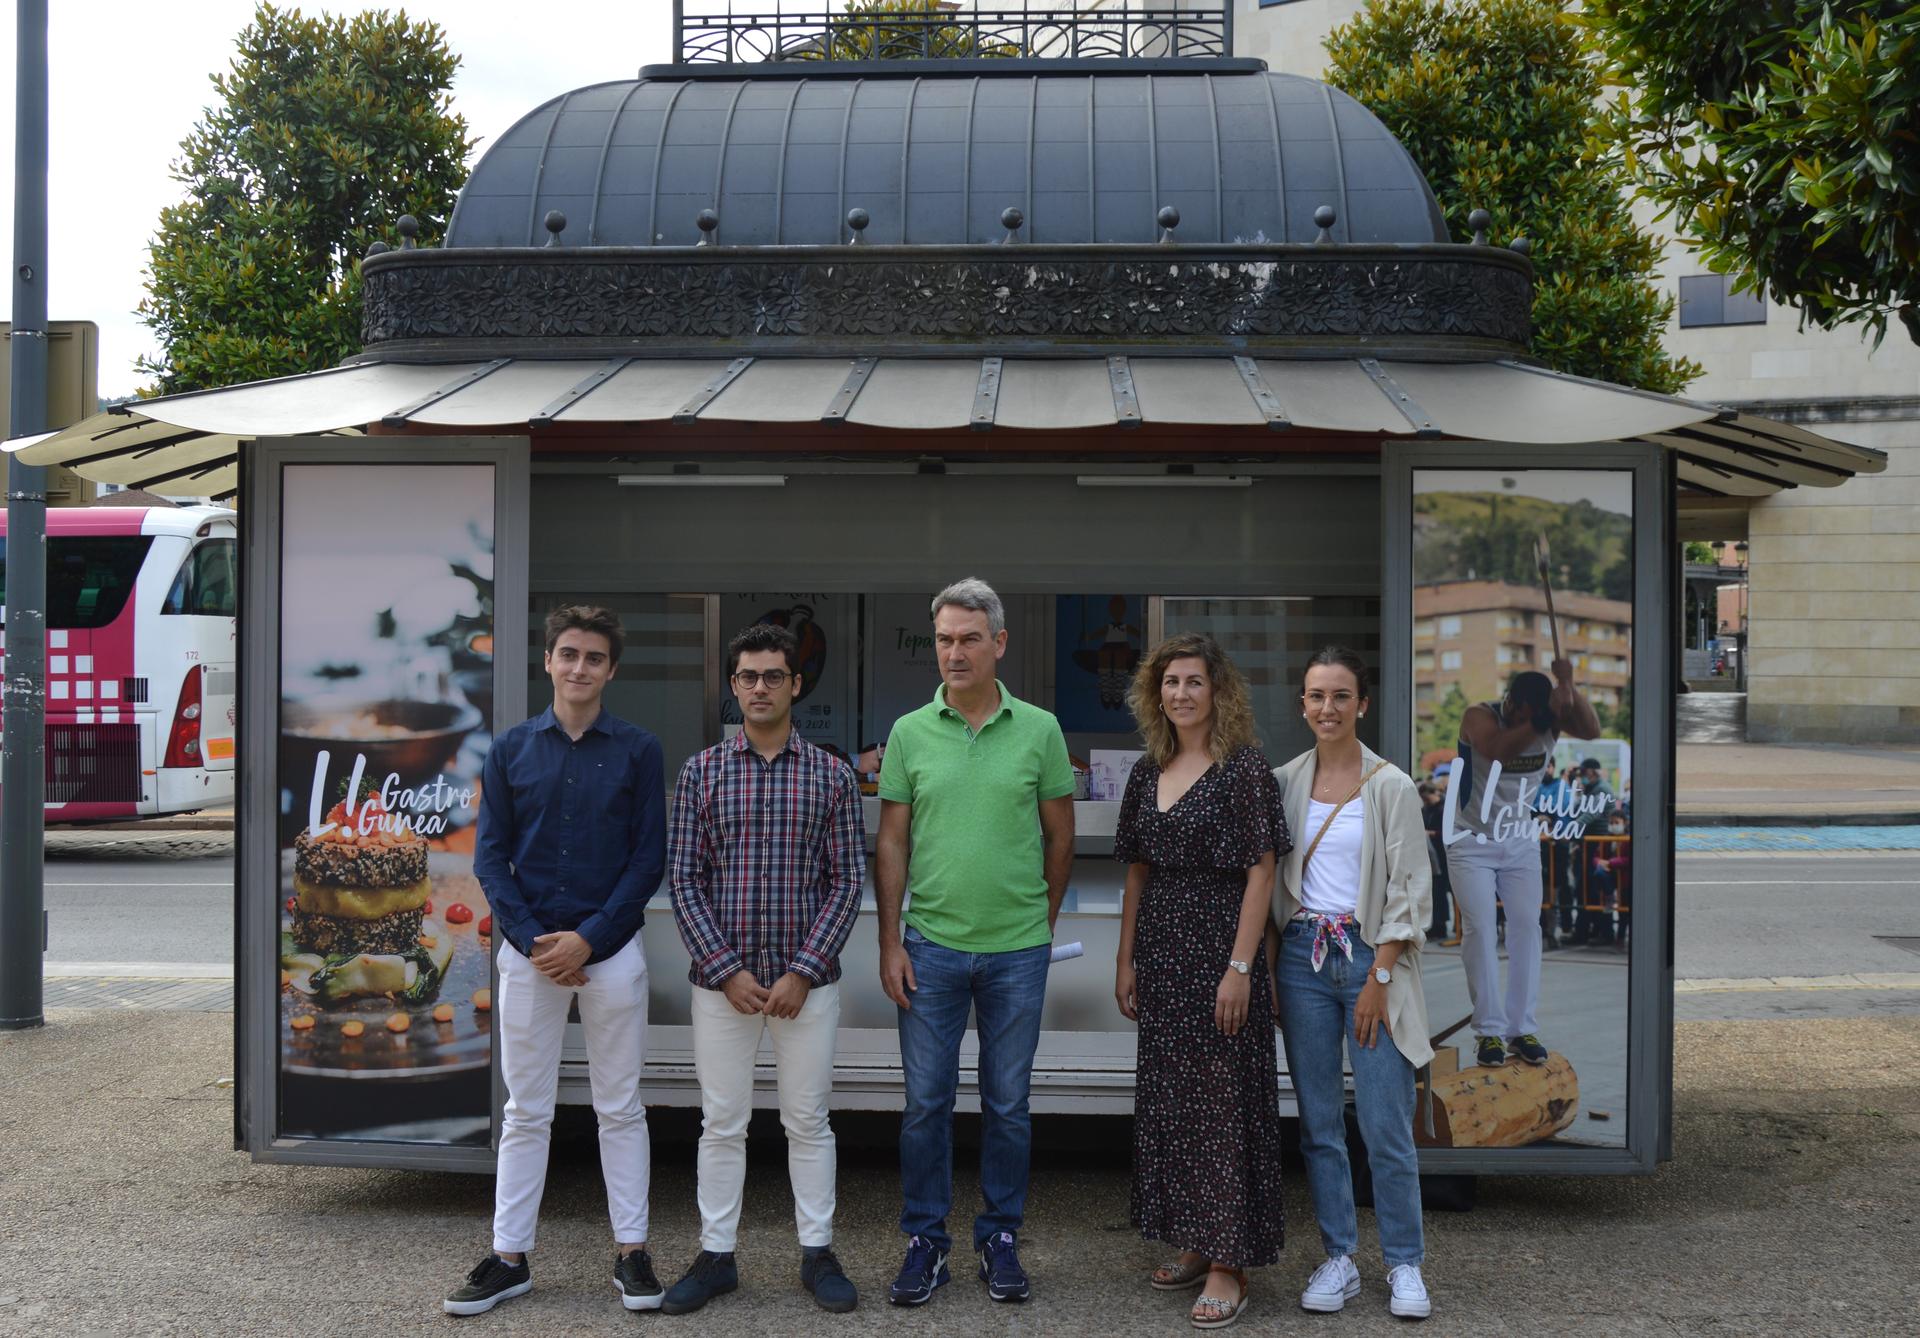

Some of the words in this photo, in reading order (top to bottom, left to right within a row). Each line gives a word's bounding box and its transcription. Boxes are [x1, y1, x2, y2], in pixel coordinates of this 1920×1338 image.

[184, 650, 199, 661] 172
[380, 772, 477, 813] Gastro
[1516, 777, 1617, 819] Kultur
[358, 798, 449, 837] Gunea
[1493, 804, 1587, 843] Gunea
